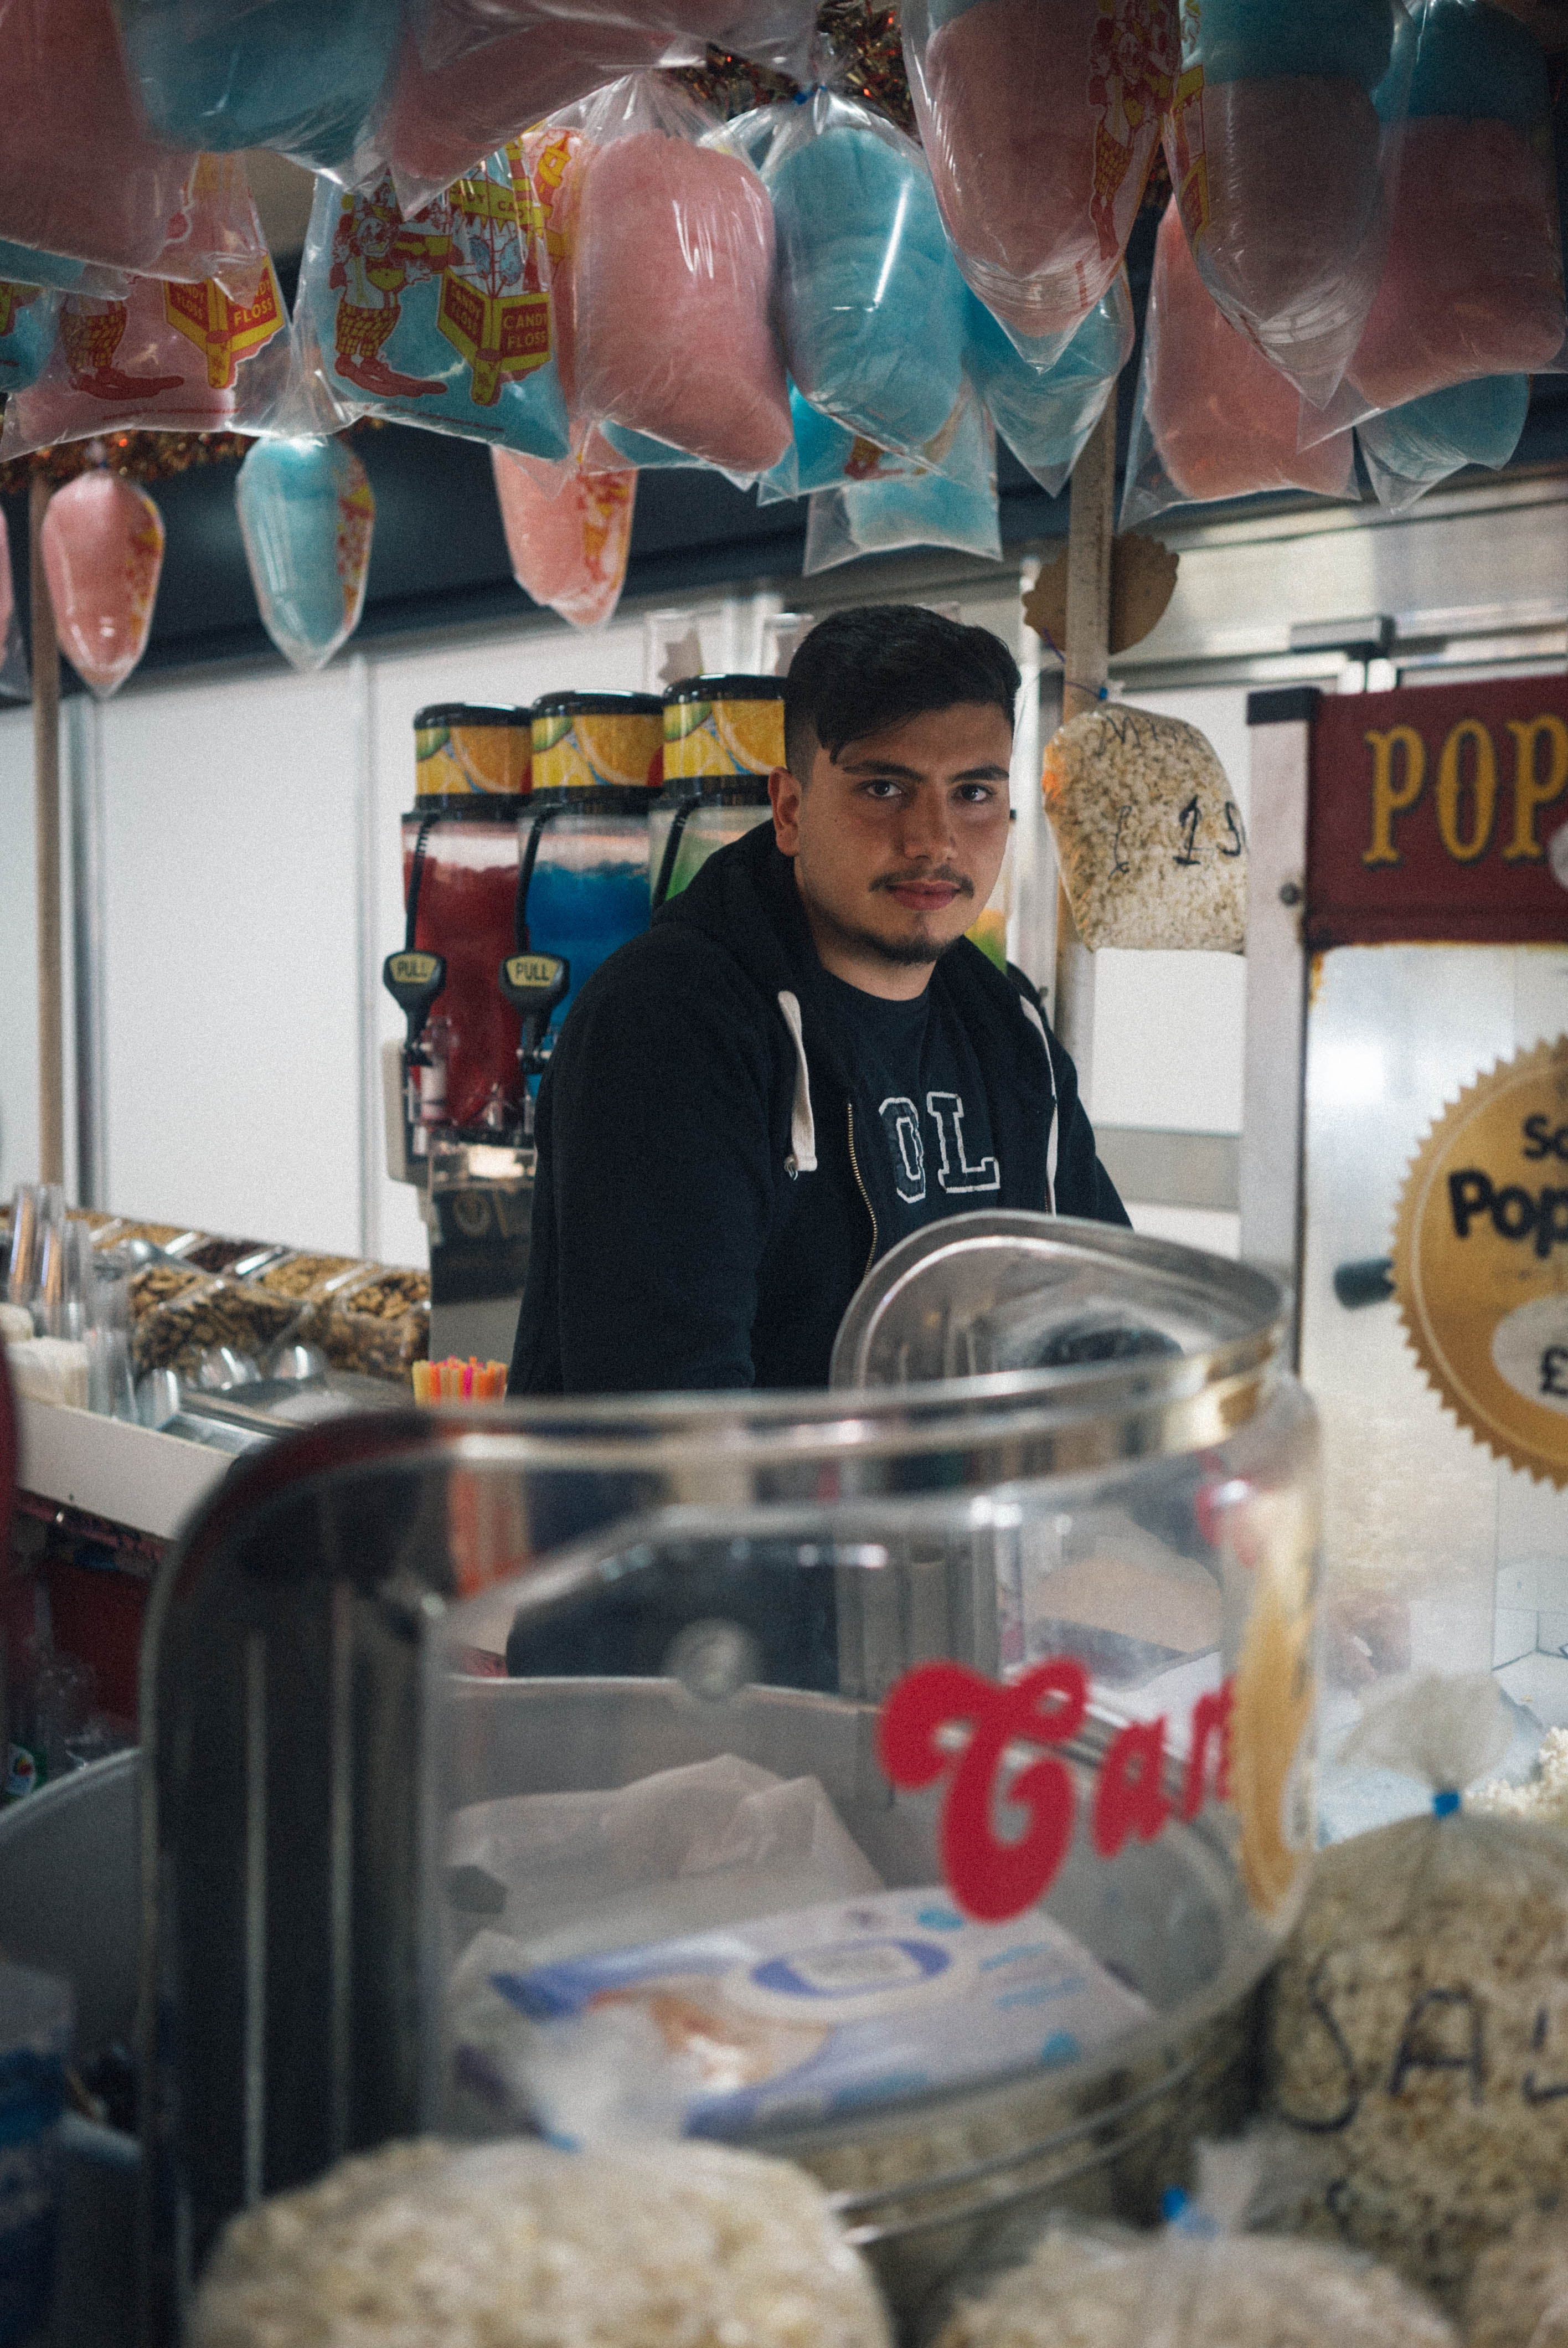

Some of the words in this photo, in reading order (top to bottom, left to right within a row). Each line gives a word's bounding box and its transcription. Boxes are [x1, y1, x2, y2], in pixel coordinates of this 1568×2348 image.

[233, 297, 273, 327] FLOSS
[397, 960, 427, 977] PULL
[515, 962, 550, 981] PULL
